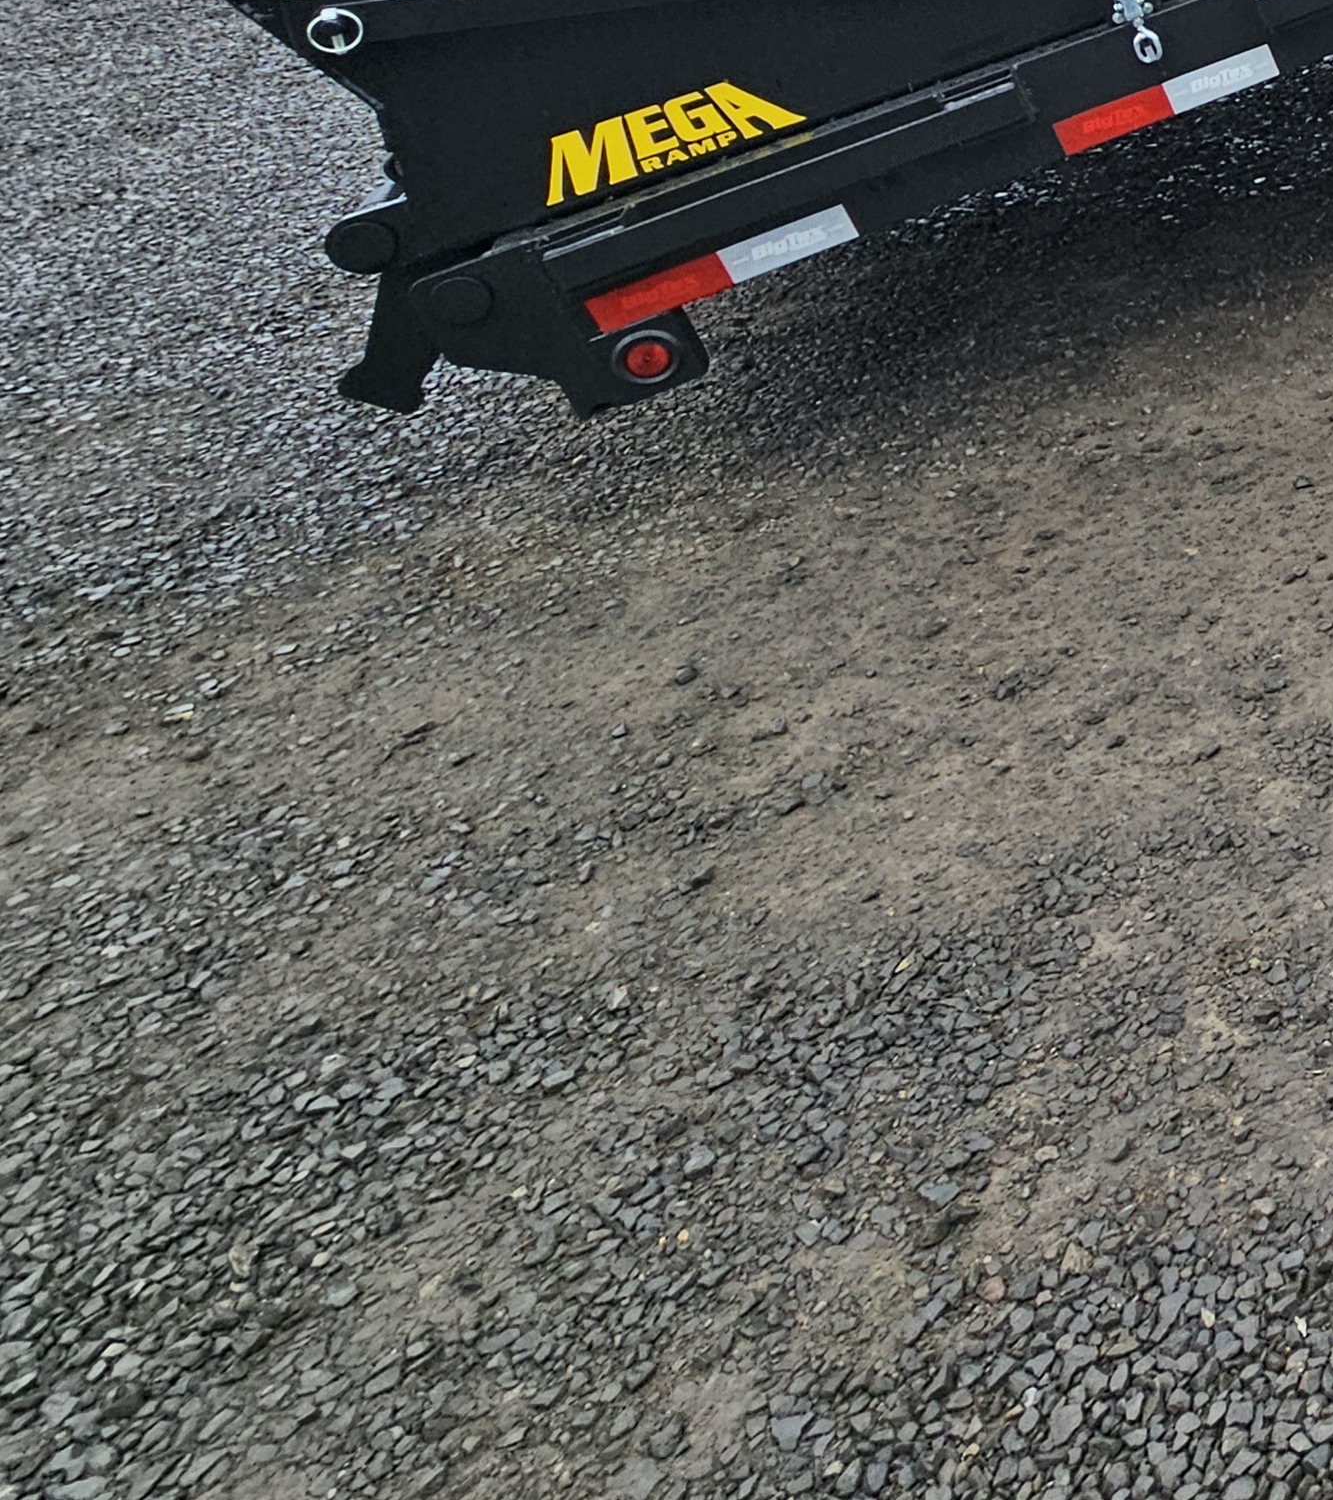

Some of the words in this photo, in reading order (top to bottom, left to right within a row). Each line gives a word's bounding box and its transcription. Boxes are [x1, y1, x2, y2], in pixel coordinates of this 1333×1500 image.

[1189, 62, 1253, 93] BigTex
[546, 81, 807, 206] MEGA
[639, 130, 738, 174] RAMP
[751, 224, 828, 261] BigTex
